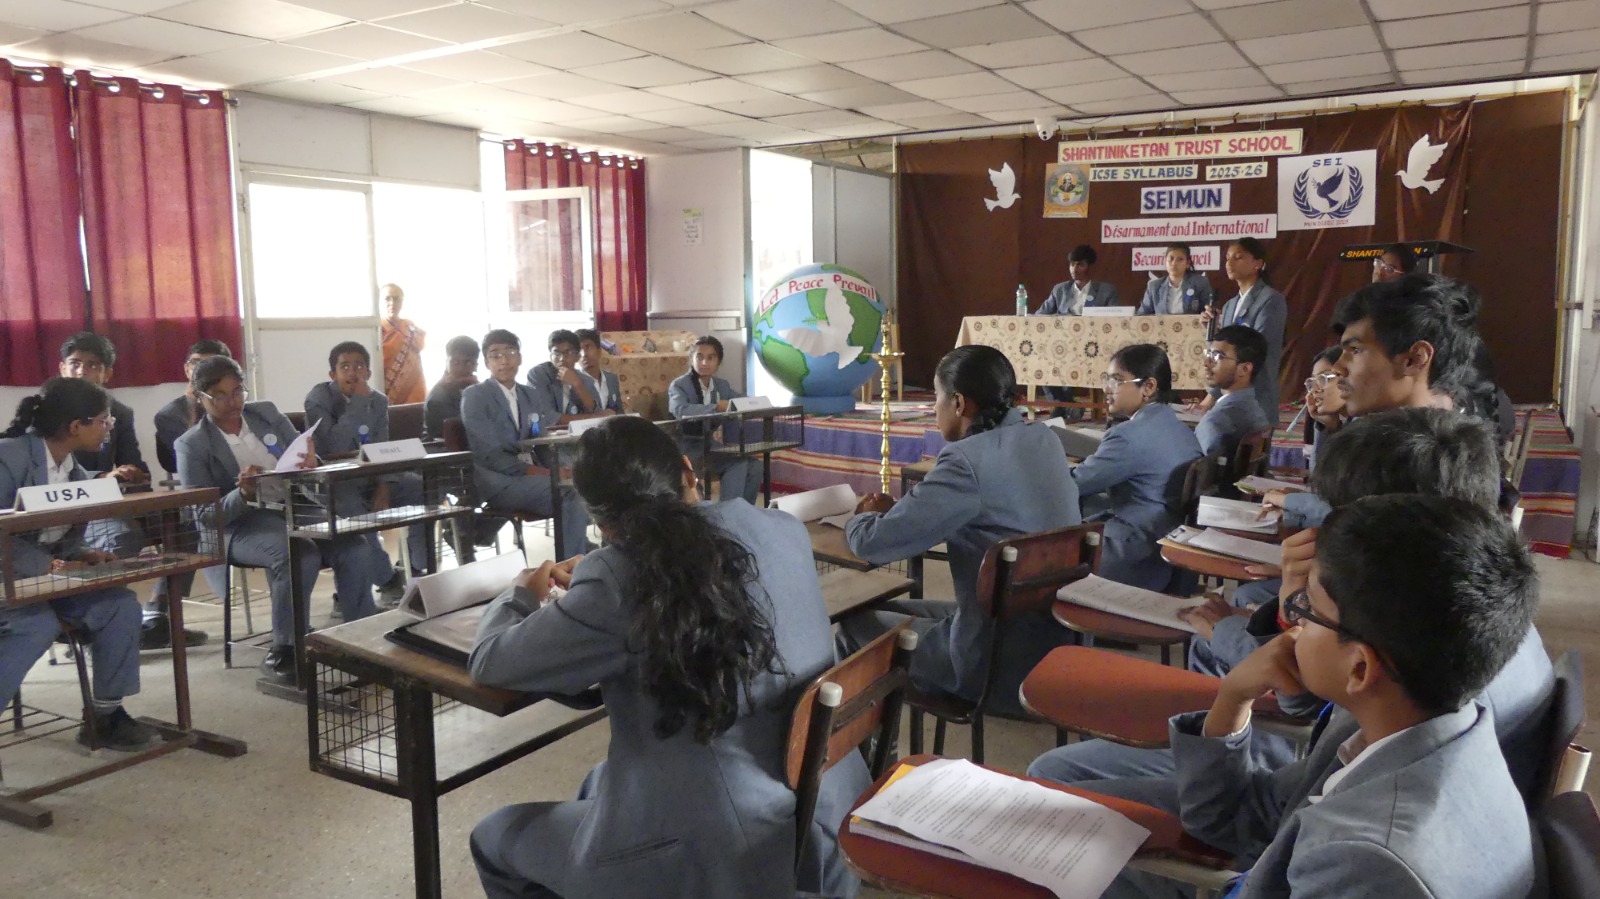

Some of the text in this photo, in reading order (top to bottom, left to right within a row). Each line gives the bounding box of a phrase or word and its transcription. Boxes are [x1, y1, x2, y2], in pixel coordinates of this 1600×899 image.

[1062, 136, 1293, 162] SHANTINIKETAN TRUST SCHOOL
[1312, 157, 1343, 168] SEI
[1092, 166, 1194, 180] ICSE SYLLABUS
[1143, 188, 1223, 210] SEIMUN
[1103, 218, 1269, 239] Disarmament and International
[1134, 251, 1167, 266] Securi
[788, 279, 824, 294] Peace
[833, 274, 879, 300] Prevail
[45, 487, 90, 503] USA
